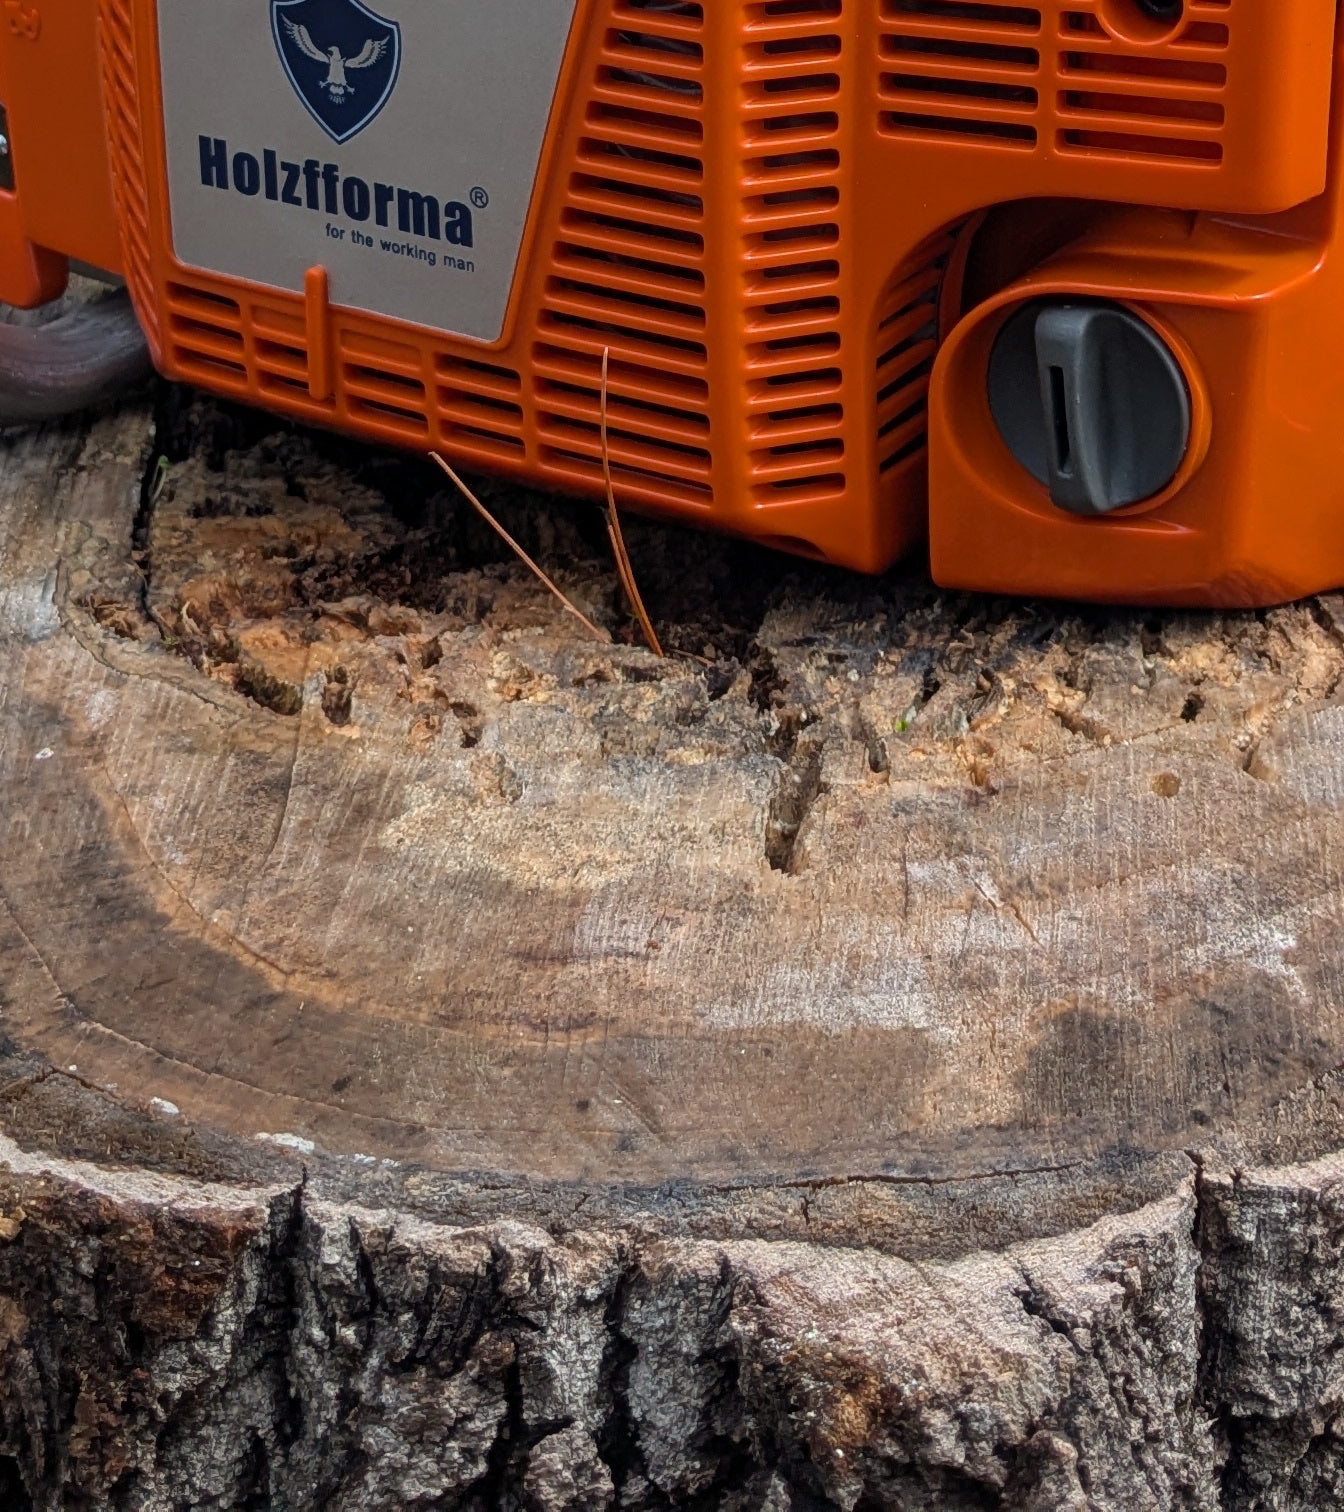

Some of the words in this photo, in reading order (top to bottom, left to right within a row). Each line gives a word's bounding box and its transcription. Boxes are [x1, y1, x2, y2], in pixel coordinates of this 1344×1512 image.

[325, 223, 345, 239] for
[351, 229, 374, 248] the
[379, 239, 436, 266] working
[443, 255, 475, 273] man
